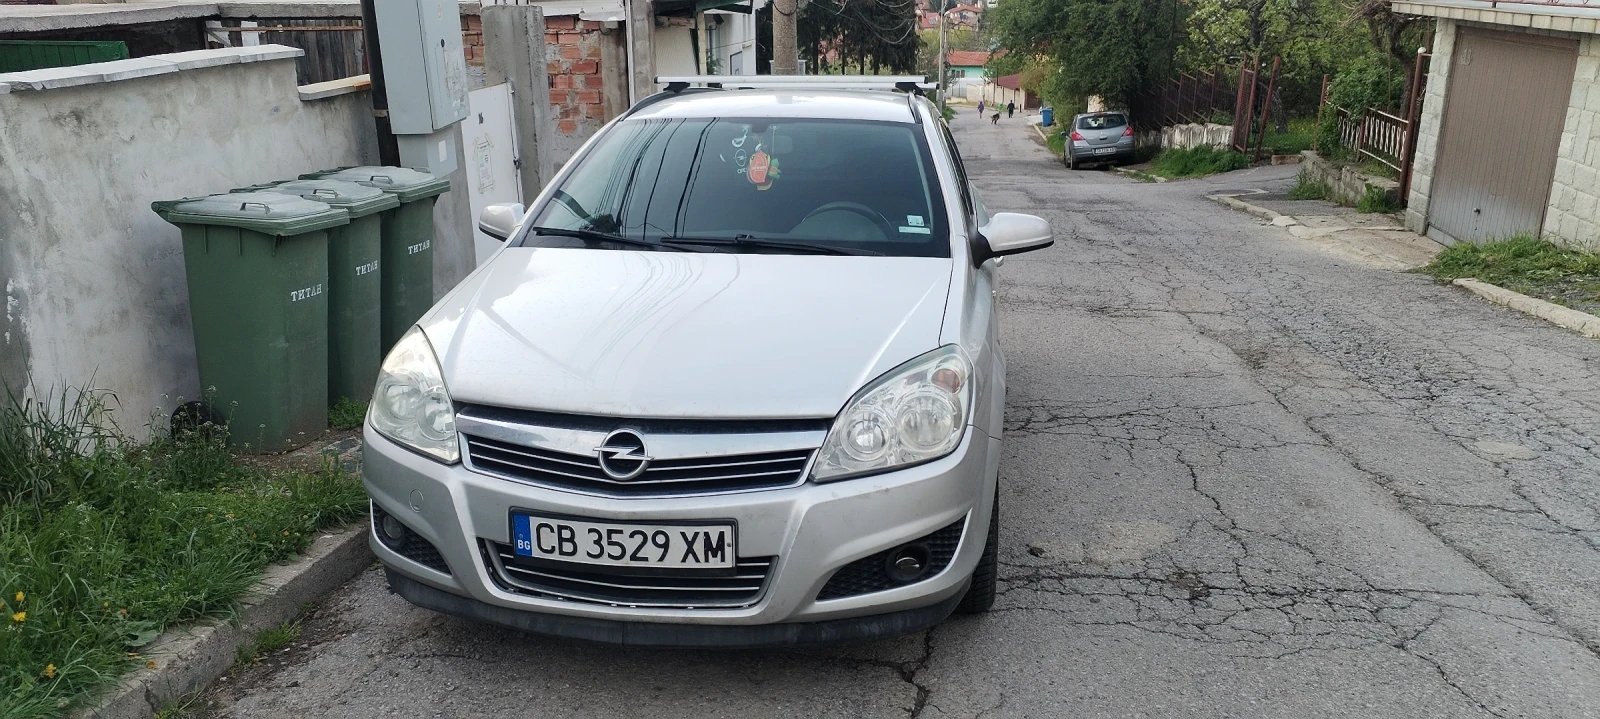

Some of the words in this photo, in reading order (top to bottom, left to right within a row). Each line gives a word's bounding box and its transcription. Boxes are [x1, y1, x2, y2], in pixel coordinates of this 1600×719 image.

[407, 240, 430, 255] ТИТАН
[355, 260, 378, 276] ТИТАН
[290, 283, 322, 302] ТИТАН
[517, 539, 531, 551] BG
[536, 522, 578, 557] CB
[586, 527, 670, 563] 3529
[679, 530, 726, 564] XM
